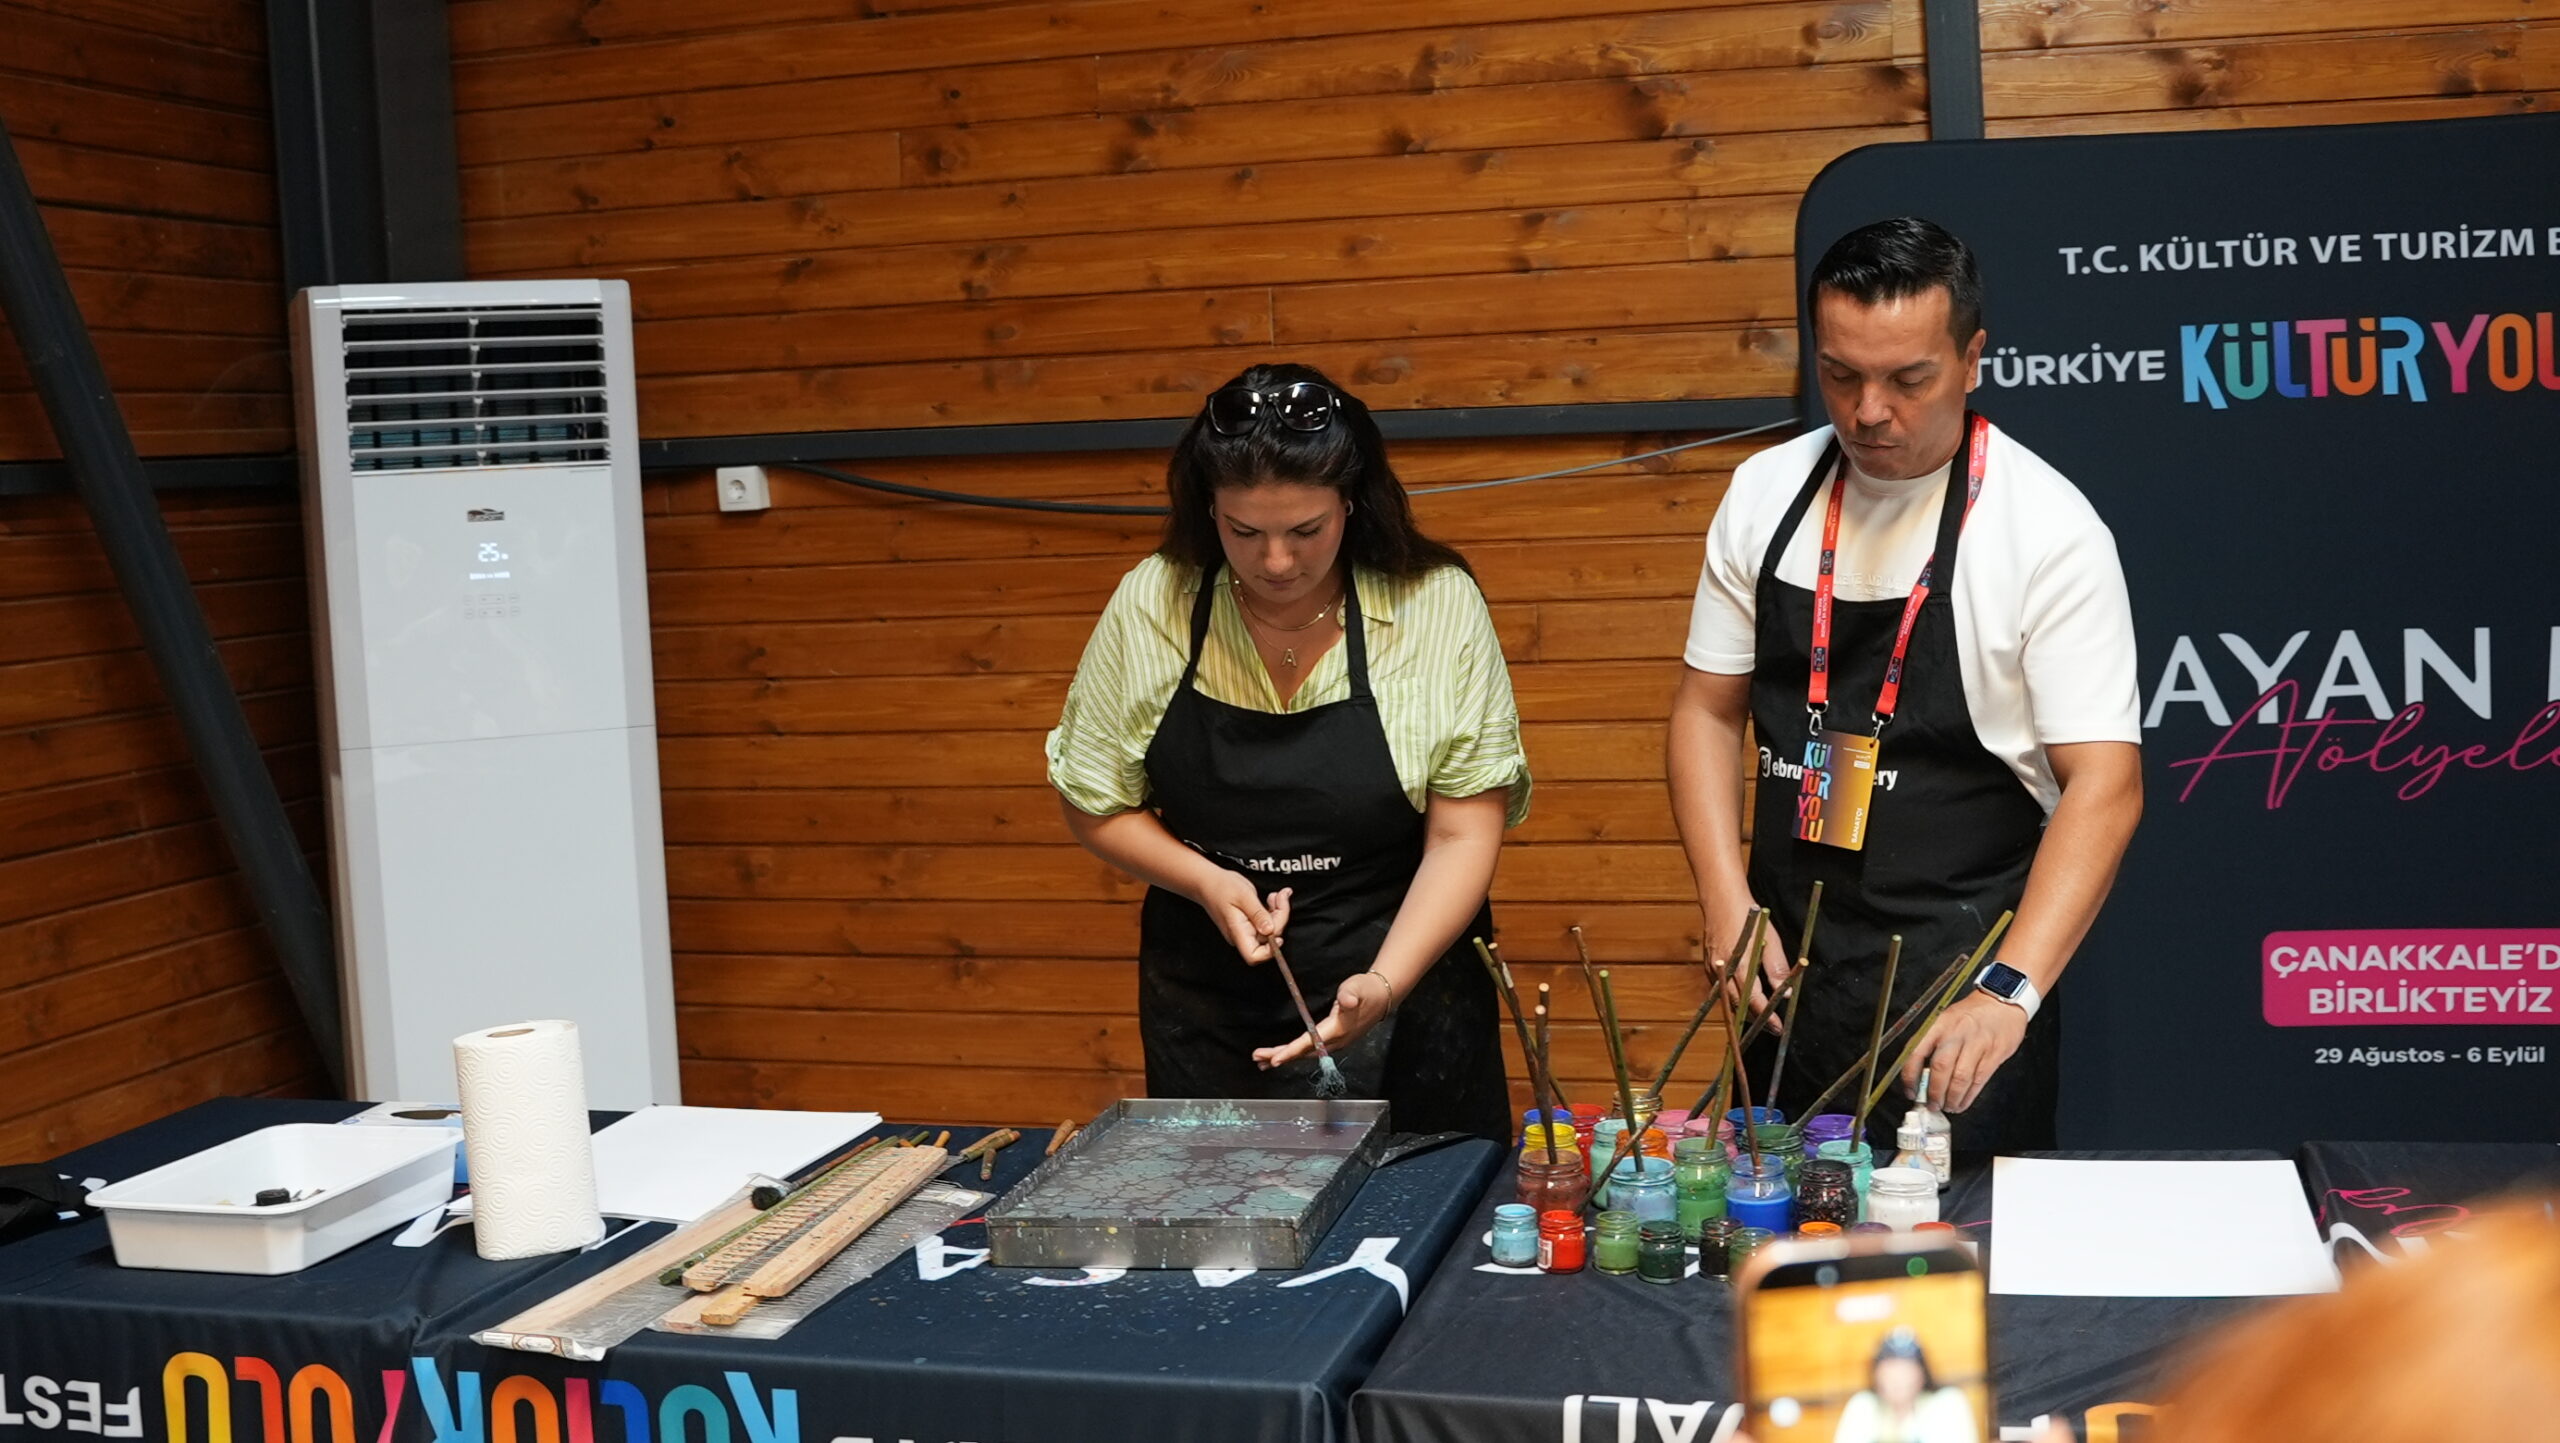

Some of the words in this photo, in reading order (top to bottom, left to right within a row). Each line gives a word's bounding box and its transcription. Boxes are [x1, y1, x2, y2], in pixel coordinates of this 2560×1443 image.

[2058, 245, 2129, 275] T.C.
[2139, 232, 2299, 272] KÜLTÜR
[2309, 234, 2362, 264] VE
[2373, 223, 2536, 260] TURİZM
[1975, 342, 2167, 388] TÜRKİYE
[2180, 316, 2428, 410] KÜLTÜR
[1803, 741, 1833, 769] KÜL
[2309, 978, 2554, 1014] BİRLİKTEYİZ
[2315, 1048, 2343, 1064] 29
[2349, 1046, 2446, 1067] Ağustos
[2467, 1047, 2482, 1063] 6
[2487, 1046, 2546, 1066] Eylül
